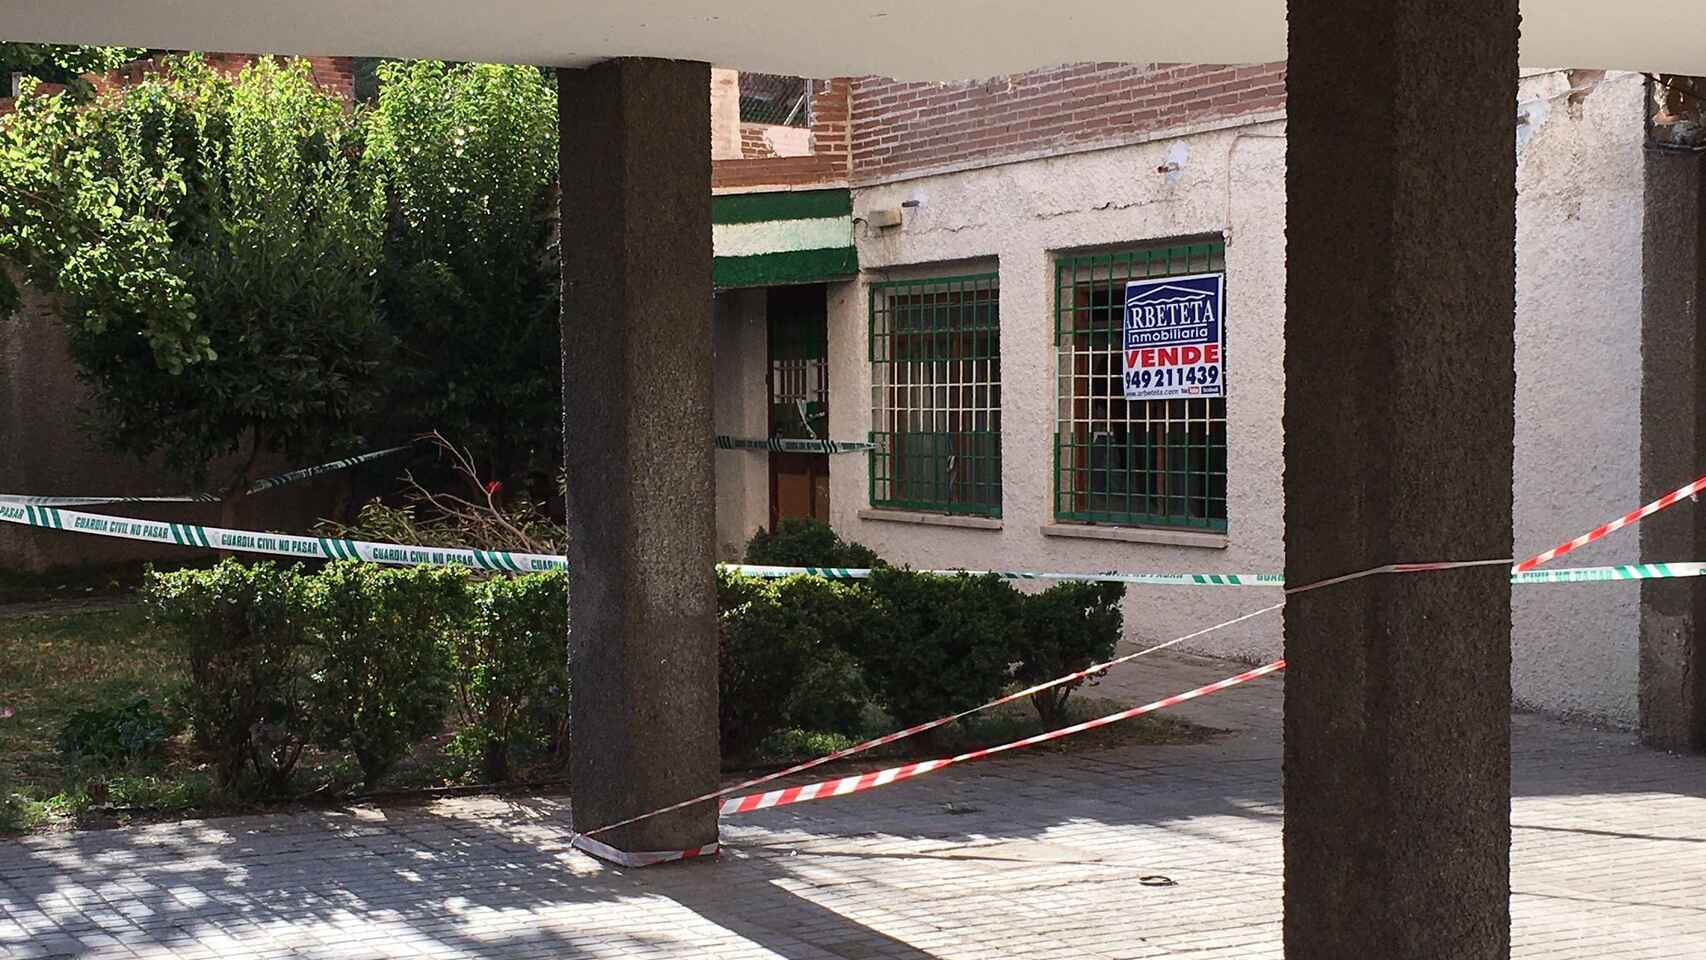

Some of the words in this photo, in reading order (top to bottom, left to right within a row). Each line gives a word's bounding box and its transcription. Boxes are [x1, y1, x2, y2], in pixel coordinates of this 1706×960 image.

[1128, 327, 1208, 343] inmobiliaria
[1126, 344, 1218, 368] VENDE
[74, 516, 108, 532] GUARDIA
[110, 521, 130, 535] CIVIL
[130, 524, 142, 536] NO
[143, 525, 170, 539] PASAR
[222, 533, 255, 548] GUARDIA
[257, 537, 277, 551] CIVIL
[279, 539, 289, 552] NO
[292, 540, 318, 554] PASAR
[373, 547, 408, 562] GUARDIA
[410, 550, 431, 563] CIVIL
[433, 552, 444, 564] NO
